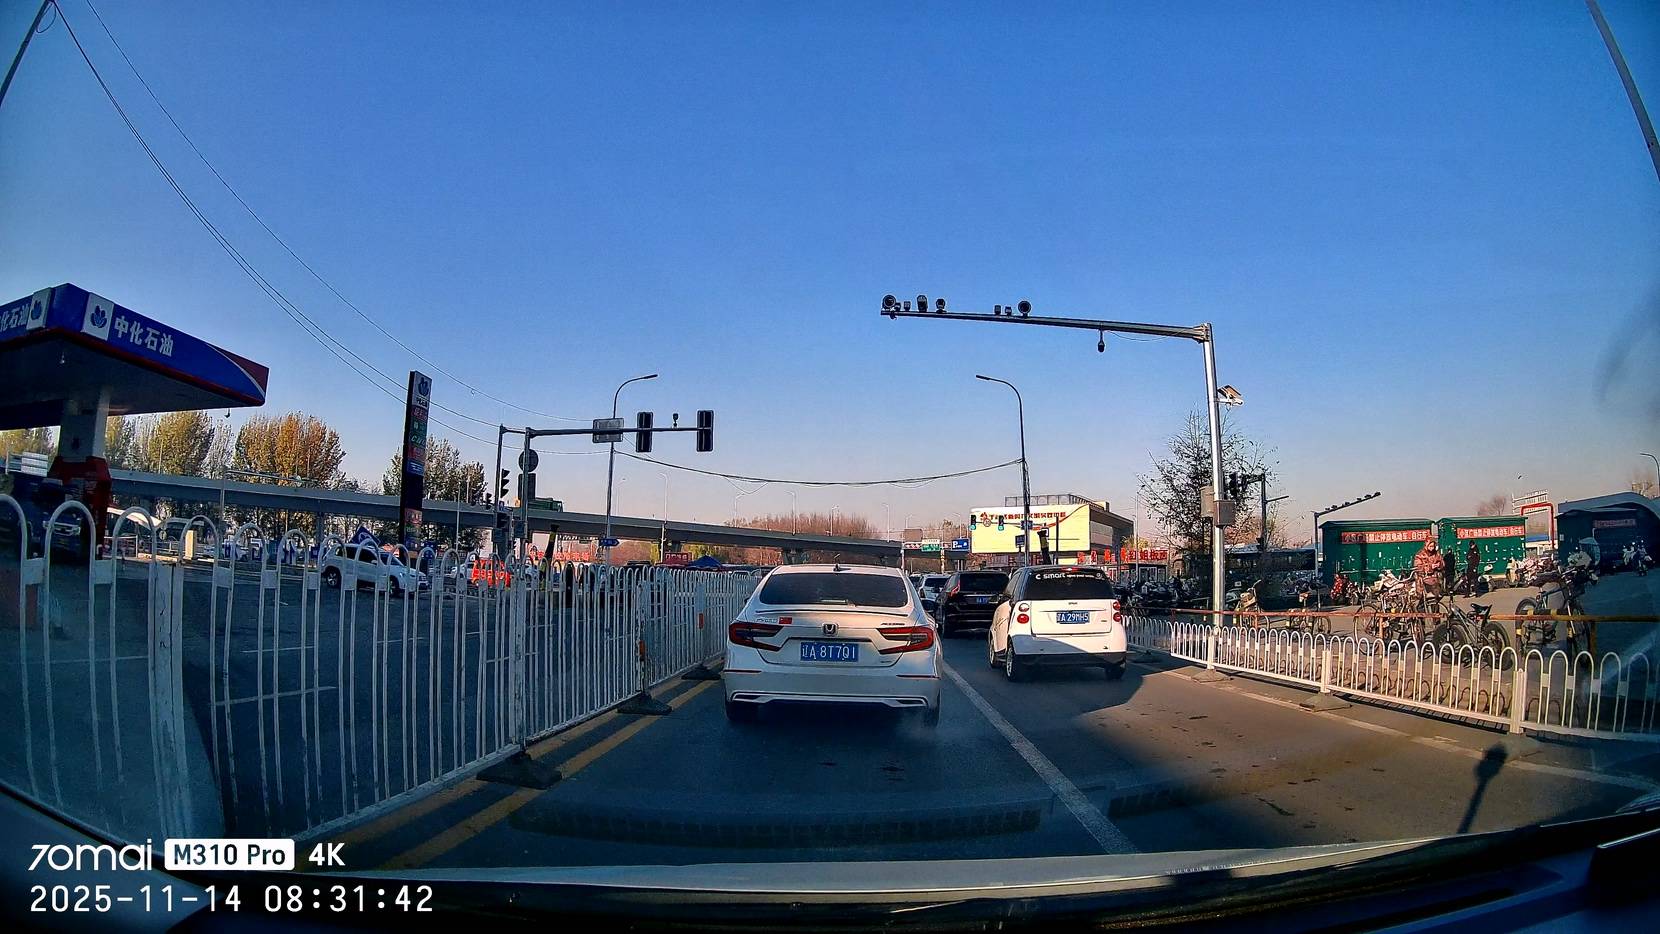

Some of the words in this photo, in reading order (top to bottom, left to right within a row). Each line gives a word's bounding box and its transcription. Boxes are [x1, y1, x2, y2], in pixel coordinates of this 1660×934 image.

[0, 303, 31, 332] 化石油
[114, 315, 175, 357] 中化石油
